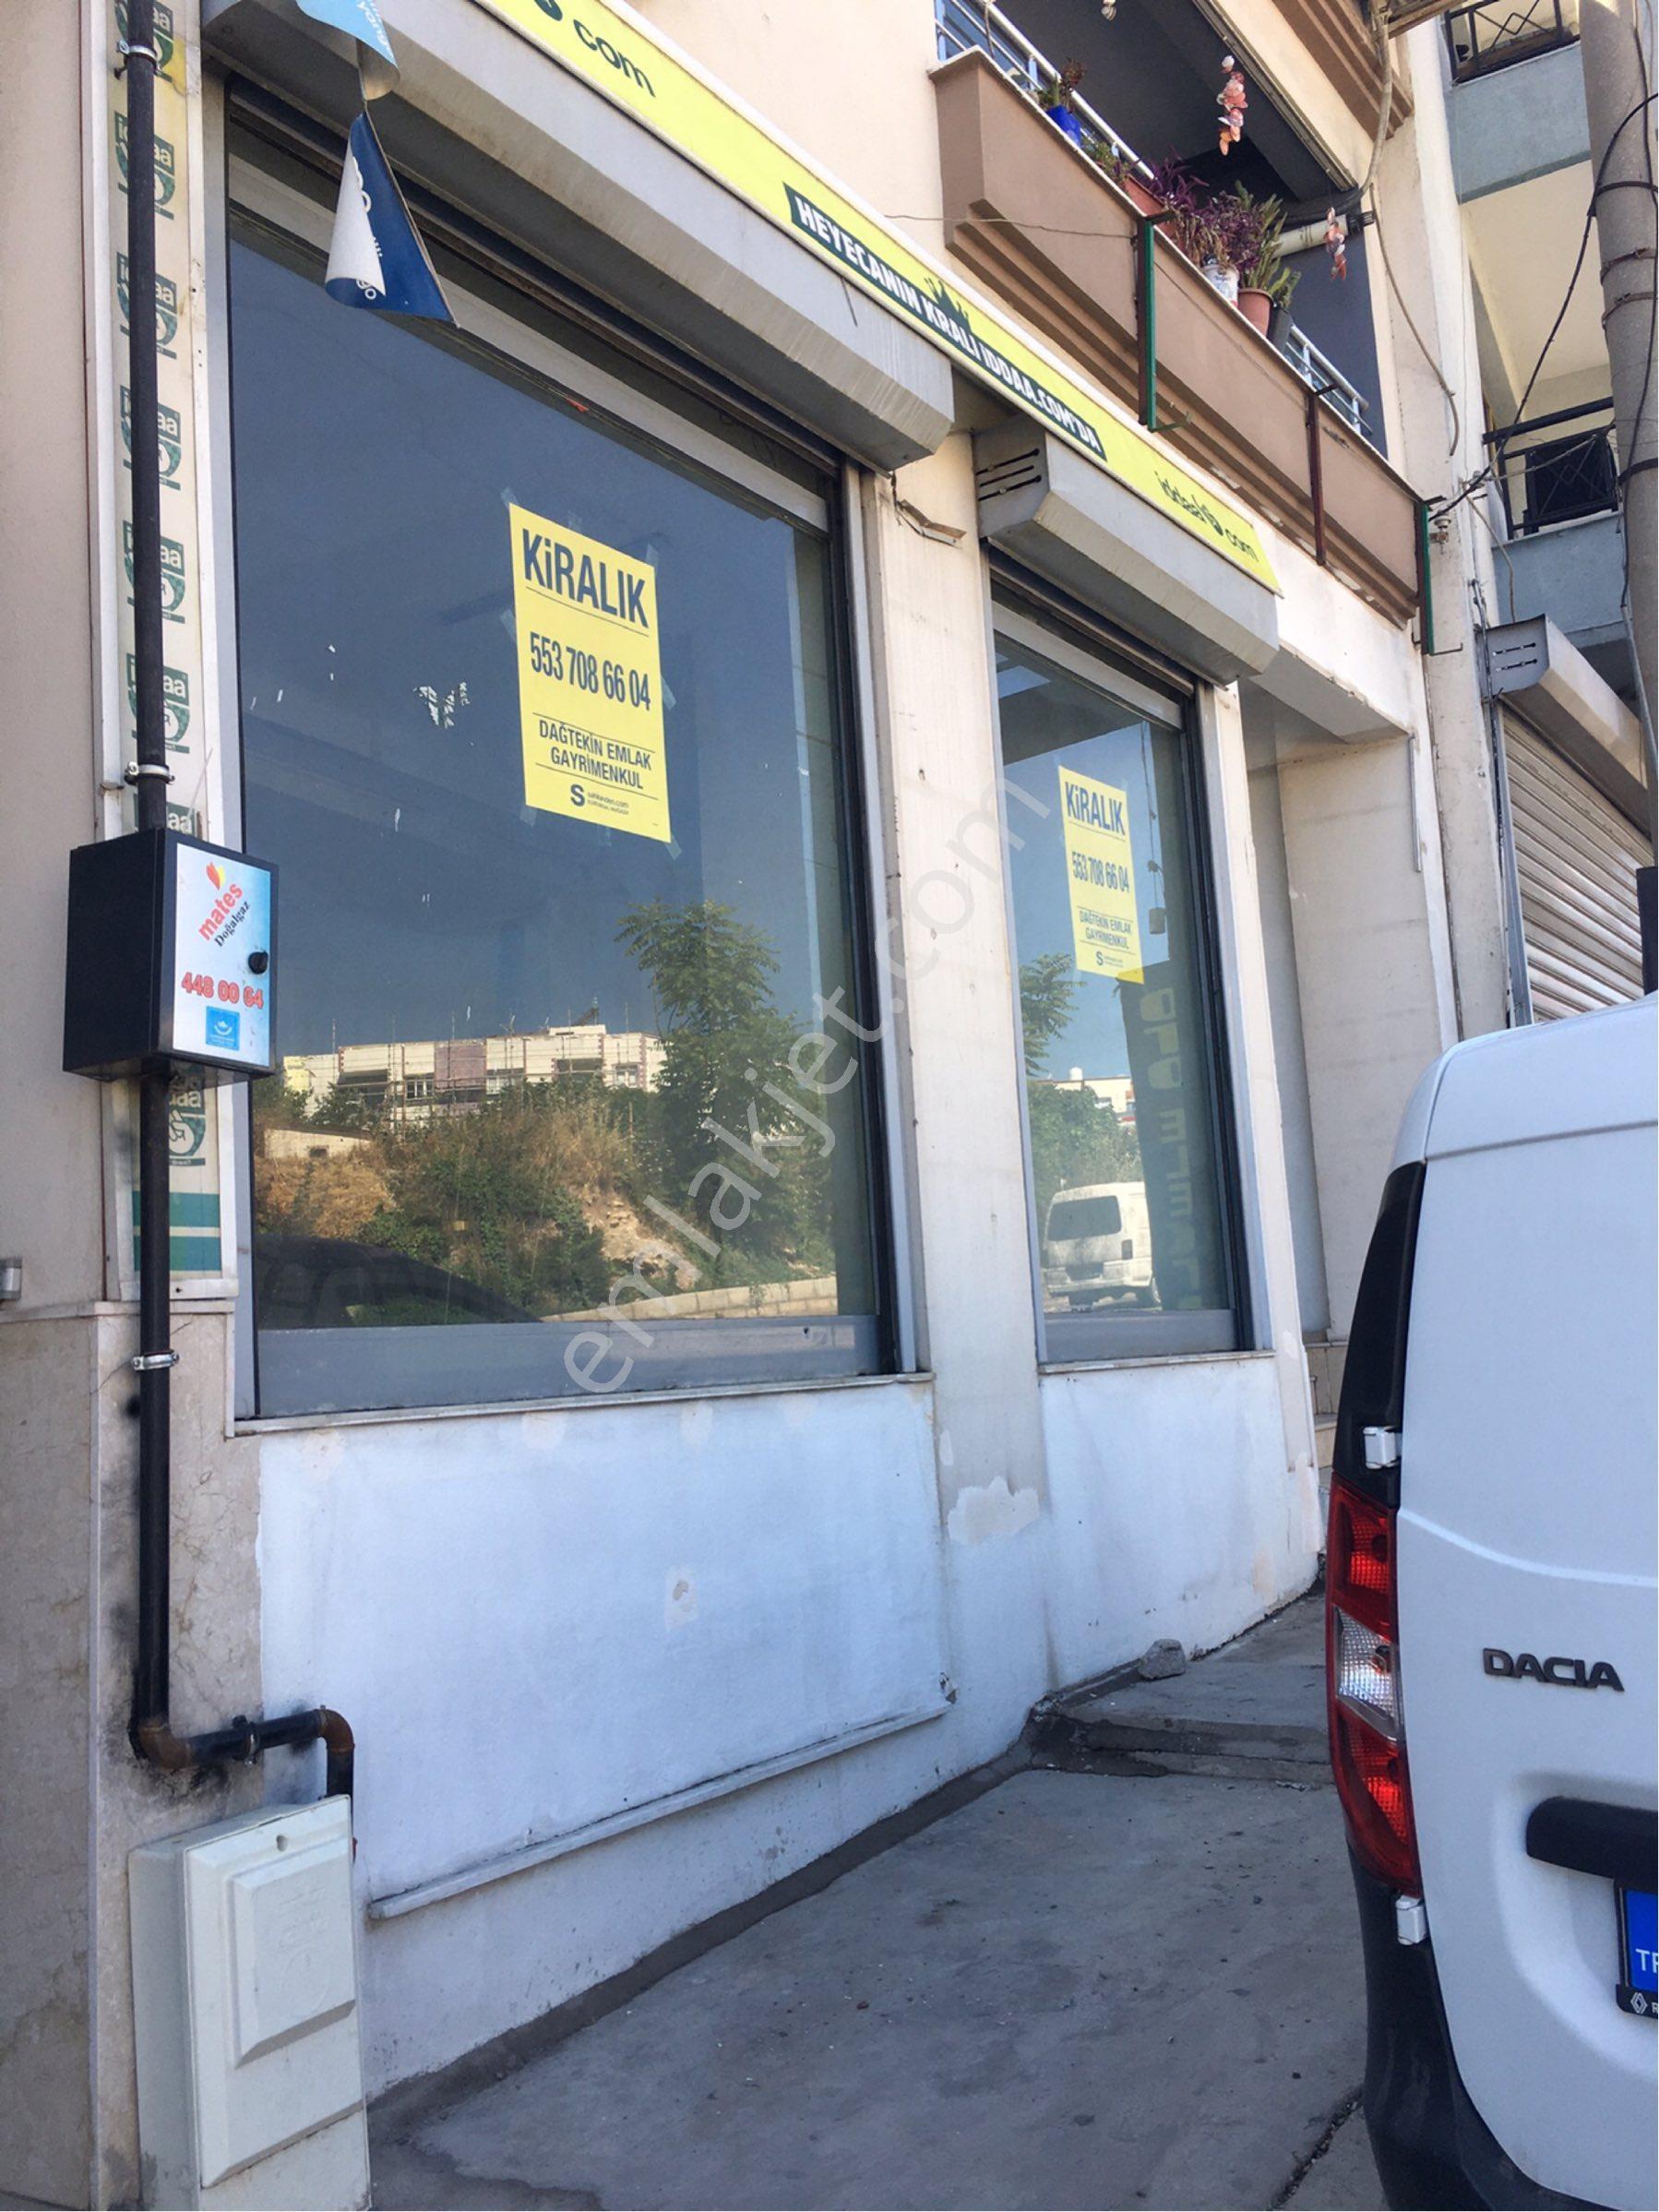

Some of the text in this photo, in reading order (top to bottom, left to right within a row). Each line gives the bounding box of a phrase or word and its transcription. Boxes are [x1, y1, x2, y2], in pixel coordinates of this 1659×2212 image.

[794, 195, 923, 316] HEYECANIN
[921, 295, 983, 361] KRALI
[530, 632, 650, 711] 553 708 66 04
[539, 719, 651, 771] DAĞTEKİN EMLAK
[551, 747, 643, 789] GAYRİMENKUL
[570, 783, 585, 807] S
[1071, 851, 1130, 893] 553 708 66 04
[197, 883, 243, 941] mates
[214, 901, 251, 948] Doğalgaz
[1110, 919, 1132, 935] EMLAK
[181, 972, 264, 1010] 448 00 64
[1482, 1647, 1625, 1692] DACIA
